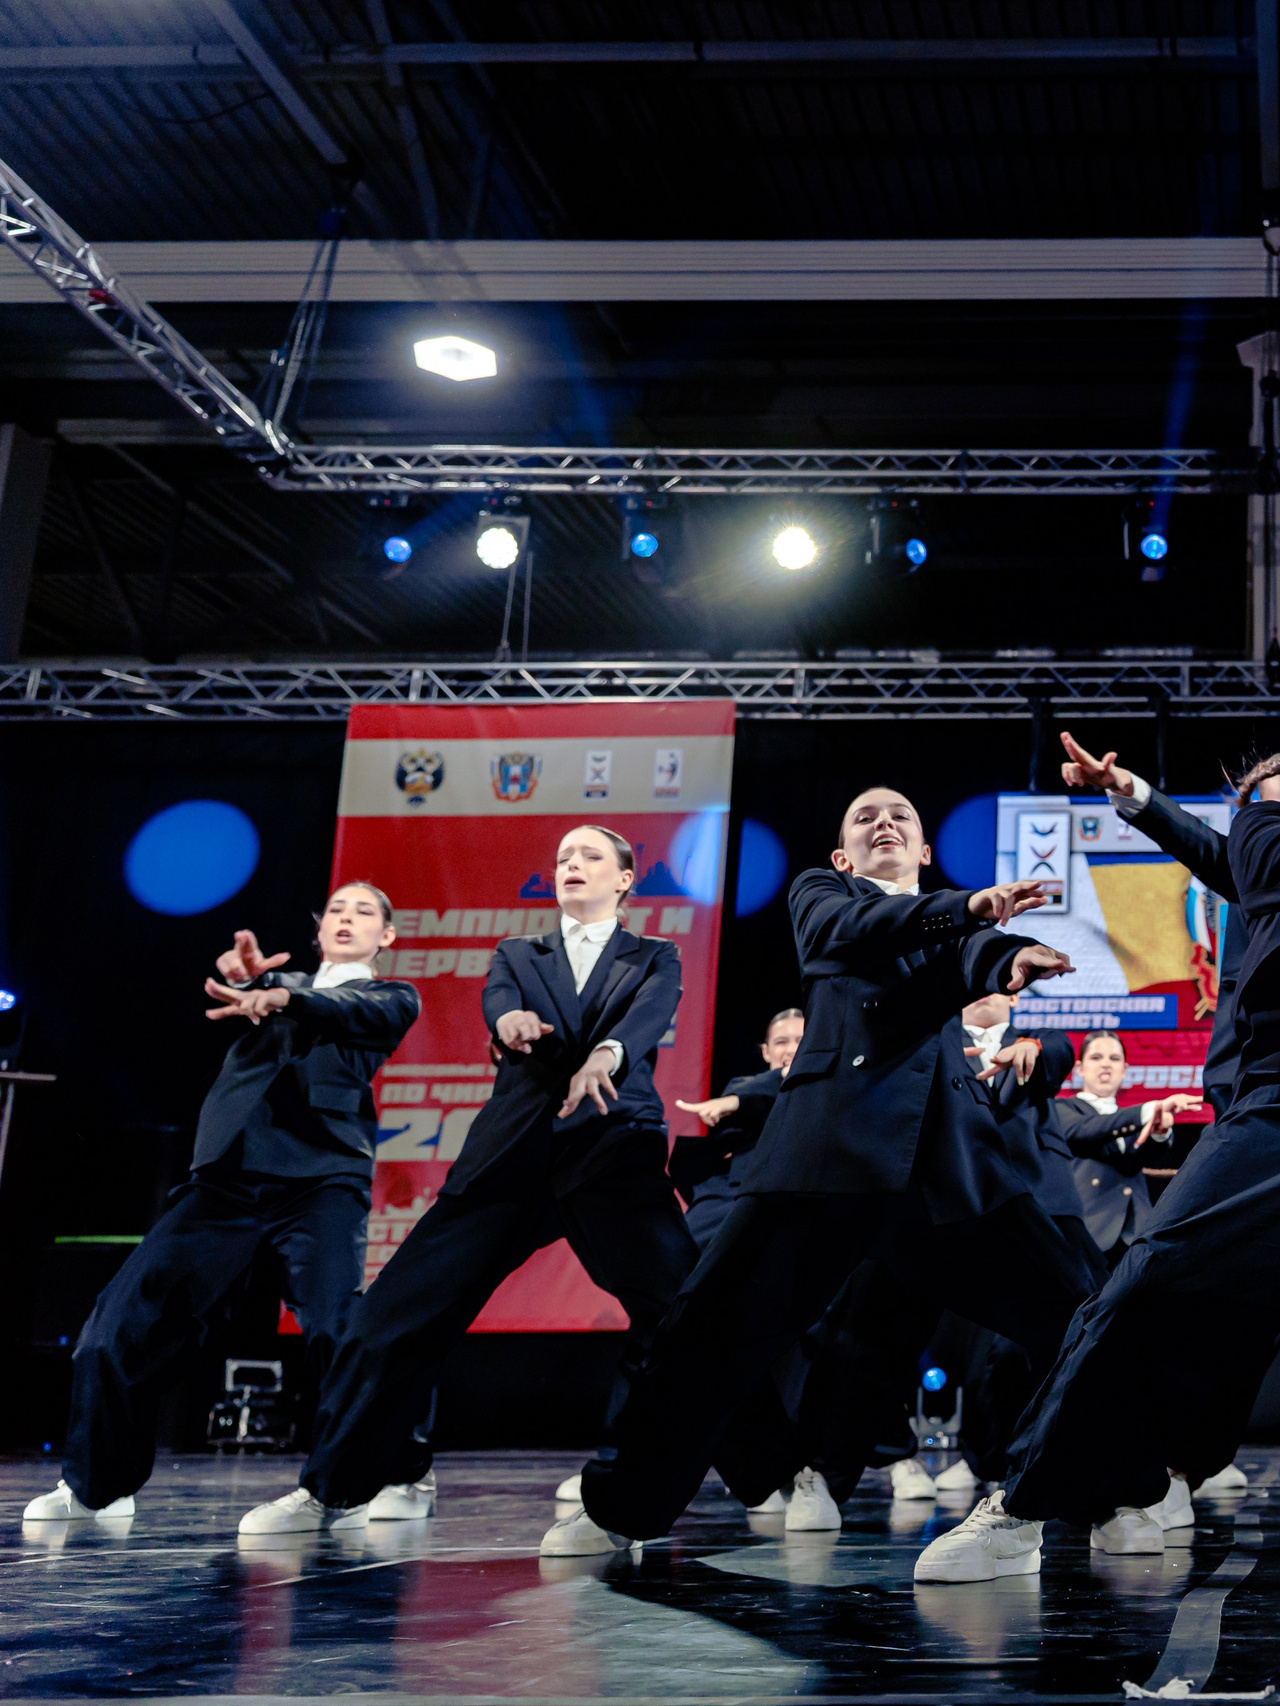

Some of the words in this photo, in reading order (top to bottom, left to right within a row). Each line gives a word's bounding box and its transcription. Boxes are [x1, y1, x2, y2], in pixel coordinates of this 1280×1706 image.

[391, 907, 653, 938] ЕМПИОТ
[658, 906, 693, 935] И
[380, 1083, 427, 1104] ПО
